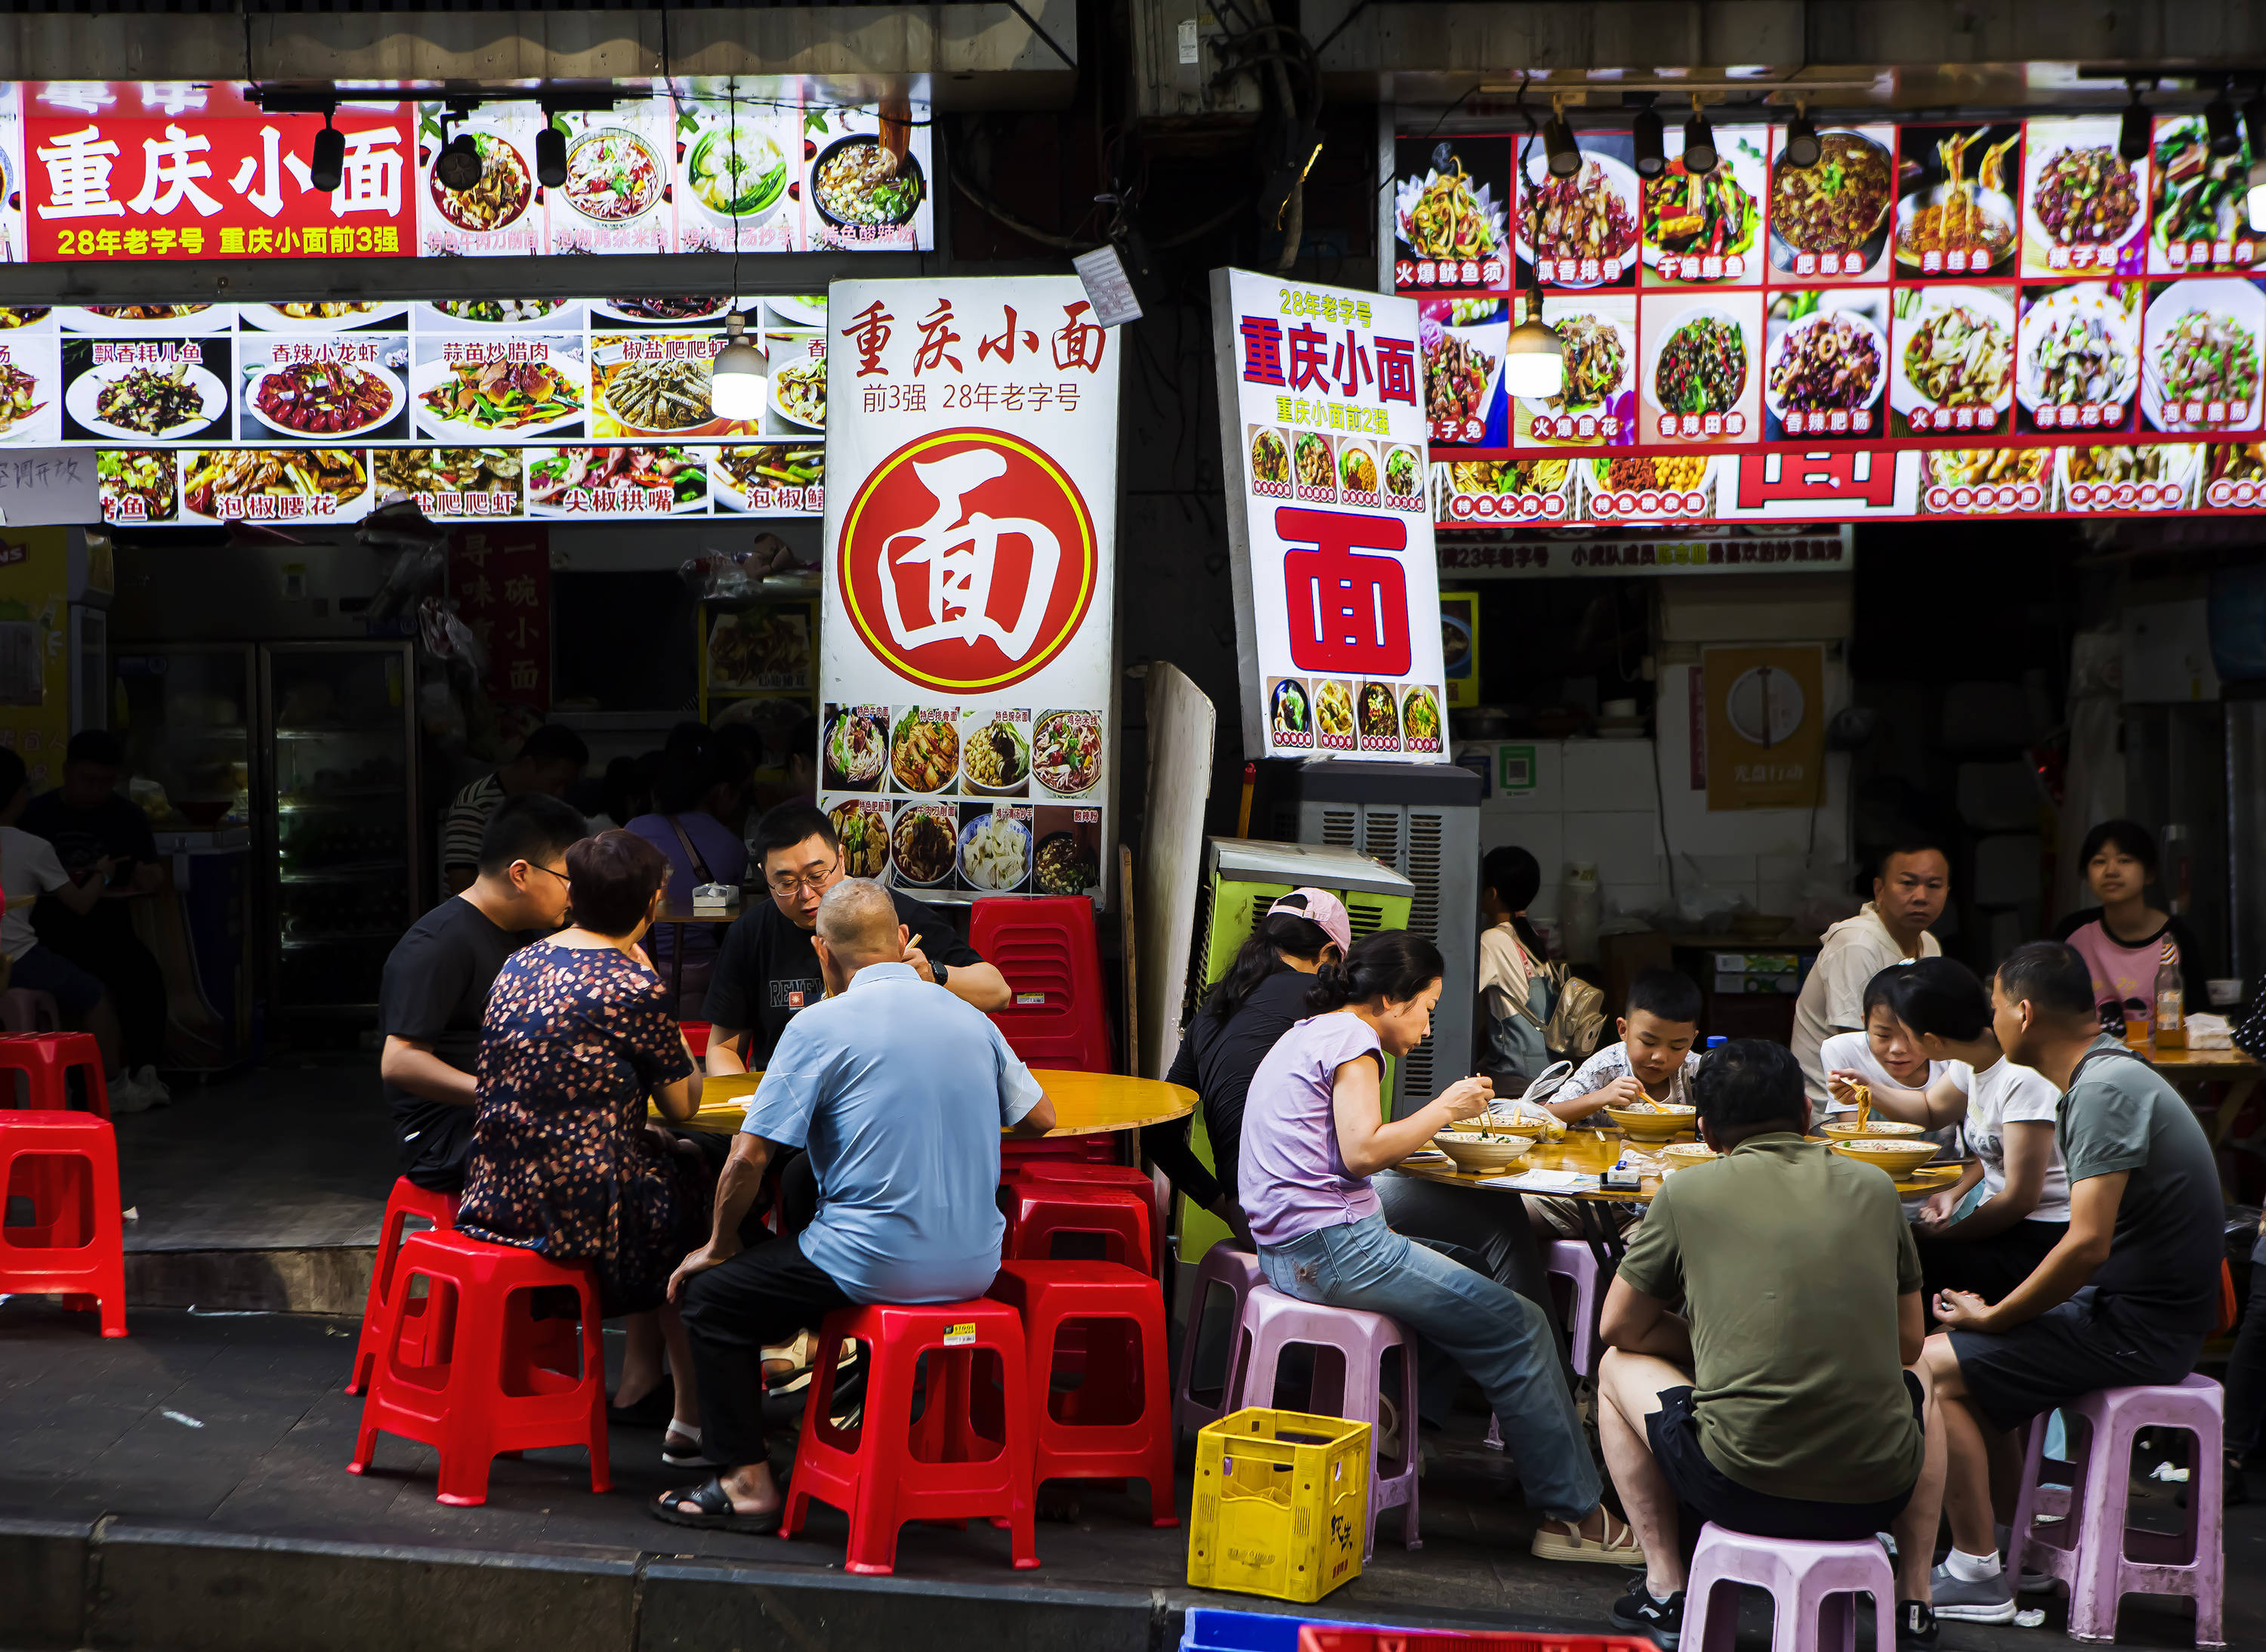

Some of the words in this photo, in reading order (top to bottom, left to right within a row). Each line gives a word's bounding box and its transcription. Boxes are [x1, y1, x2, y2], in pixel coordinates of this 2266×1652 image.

[37, 123, 404, 219] 重庆小面
[57, 229, 205, 256] 28年老字号
[219, 226, 400, 254] 重庆小面前3强
[427, 231, 539, 251] 特色牛肉刀削面
[556, 229, 668, 249] 泡椒鸡杂米线
[683, 226, 796, 247] 鸡汁清汤抄手
[821, 223, 914, 244] 特色酸辣粉
[1797, 252, 1862, 274] 肥肠鱼
[1923, 249, 1990, 271] 美蛙鱼
[2048, 245, 2119, 268] 辣子鸡
[1396, 261, 1502, 283] 火爆鱿鱼须
[1280, 289, 1372, 328] 28年老字号
[841, 298, 1107, 378] 重庆小面
[94, 344, 202, 363] 飘香耗儿鱼
[273, 344, 378, 363] 香辣小龙虾
[443, 342, 549, 363] 蒜苗炒腊肉
[622, 340, 728, 360] 椒盐爬爬虾
[1240, 315, 1416, 406] 重庆小面
[863, 383, 927, 413] 前3强
[943, 381, 1081, 412] 28年老字号
[1276, 395, 1390, 435] 重庆小面前2强
[1660, 415, 1743, 434] 香辣田螺
[1786, 412, 1869, 432] 香辣肥肠
[1911, 407, 1995, 429] 火爆黄喉
[1534, 417, 1618, 437] 火爆腰花
[218, 495, 338, 518] 泡椒腰花
[564, 489, 674, 514] 尖椒拱嘴
[1456, 498, 1561, 514] 特色牛肉面
[1933, 489, 2036, 505] 特色肥肠面
[877, 448, 1061, 662] 面
[1275, 506, 1412, 676] 面
[503, 542, 539, 690] 一碗小面
[857, 706, 889, 717] 特色牛肉面
[920, 710, 958, 721] 特色排骨面
[1067, 714, 1098, 725] 鸡杂米线
[859, 801, 891, 812] 特色肥肠面
[917, 805, 955, 817] 牛肉刀削面
[1074, 810, 1099, 822] 酸辣粉
